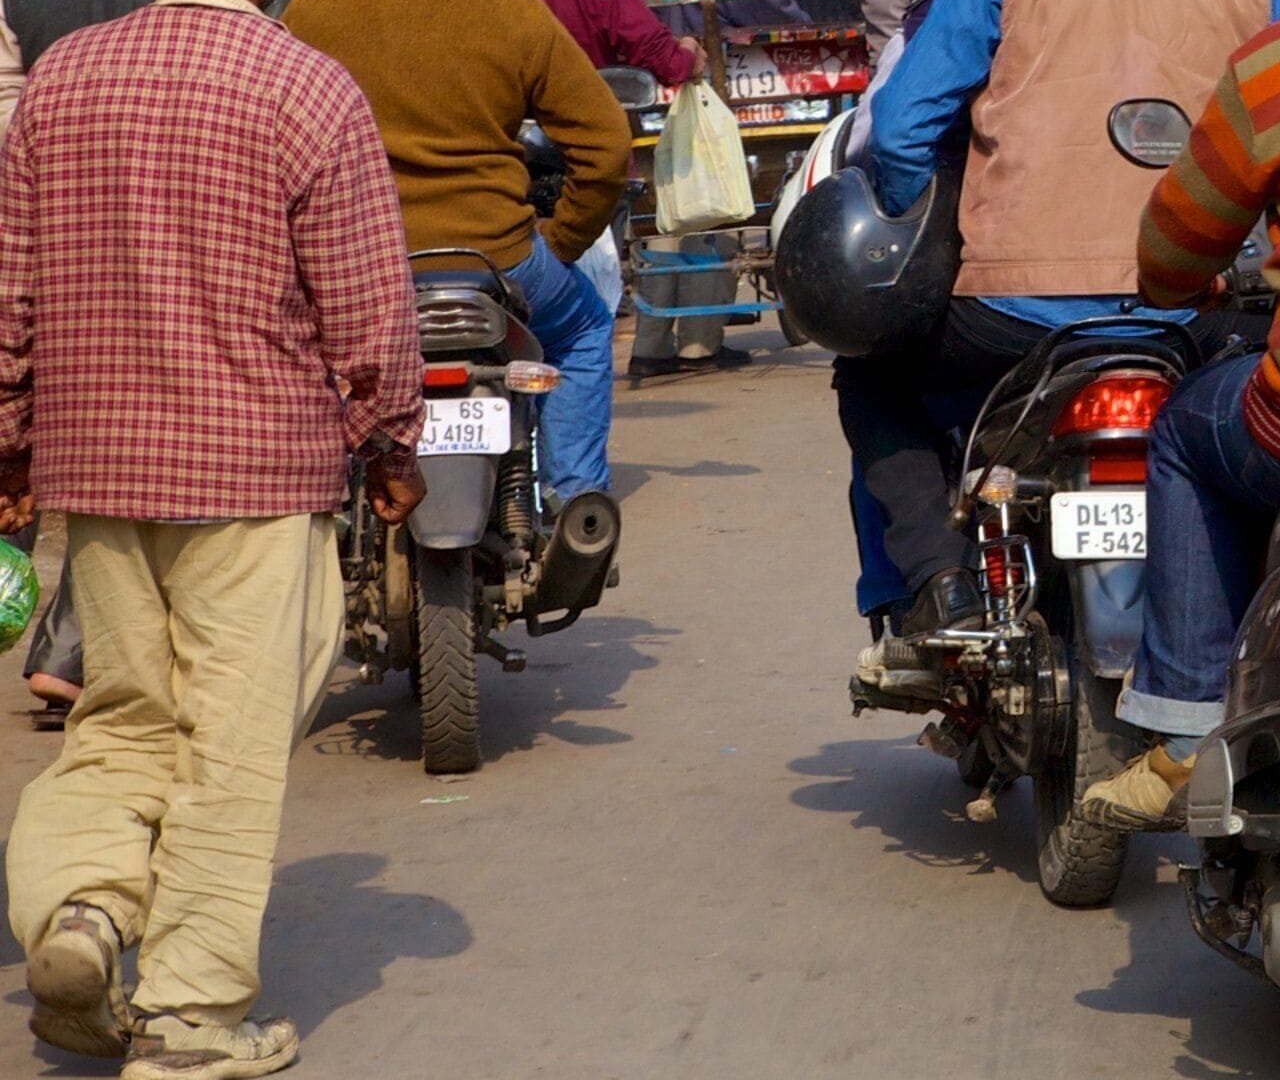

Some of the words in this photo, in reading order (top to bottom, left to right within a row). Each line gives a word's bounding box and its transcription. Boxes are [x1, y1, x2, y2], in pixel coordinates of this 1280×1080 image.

[459, 401, 484, 420] 6S
[443, 424, 484, 443] 4191
[1076, 531, 1090, 554] F
[1102, 531, 1145, 553] 542
